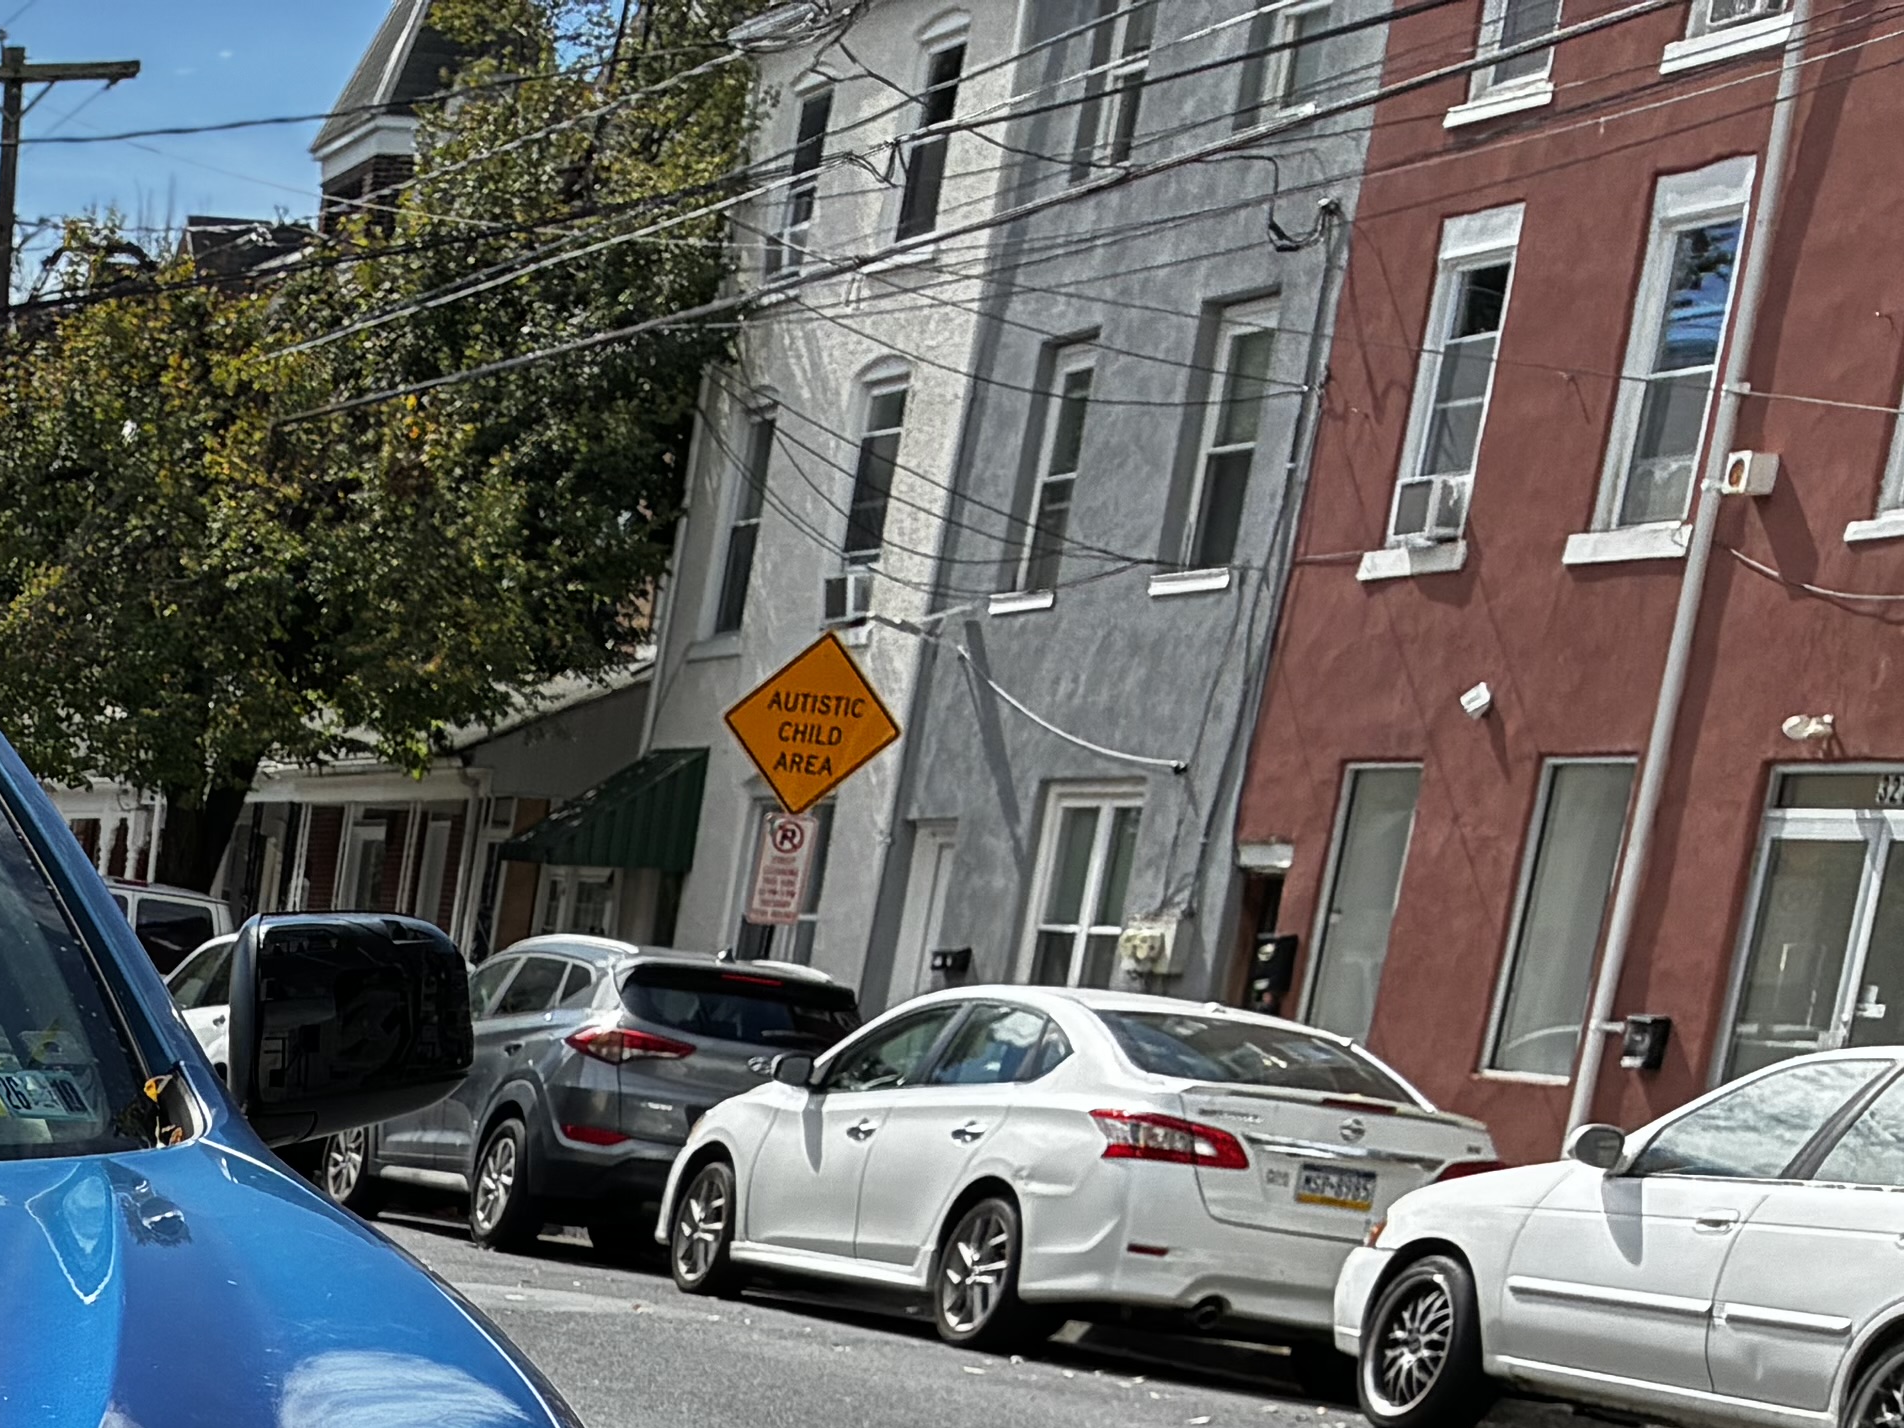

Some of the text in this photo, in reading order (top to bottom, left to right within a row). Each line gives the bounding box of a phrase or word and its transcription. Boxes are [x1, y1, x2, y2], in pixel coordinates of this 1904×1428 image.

[767, 690, 866, 718] AUTISTIC
[778, 721, 842, 746] CHILD
[773, 751, 832, 776] AREA
